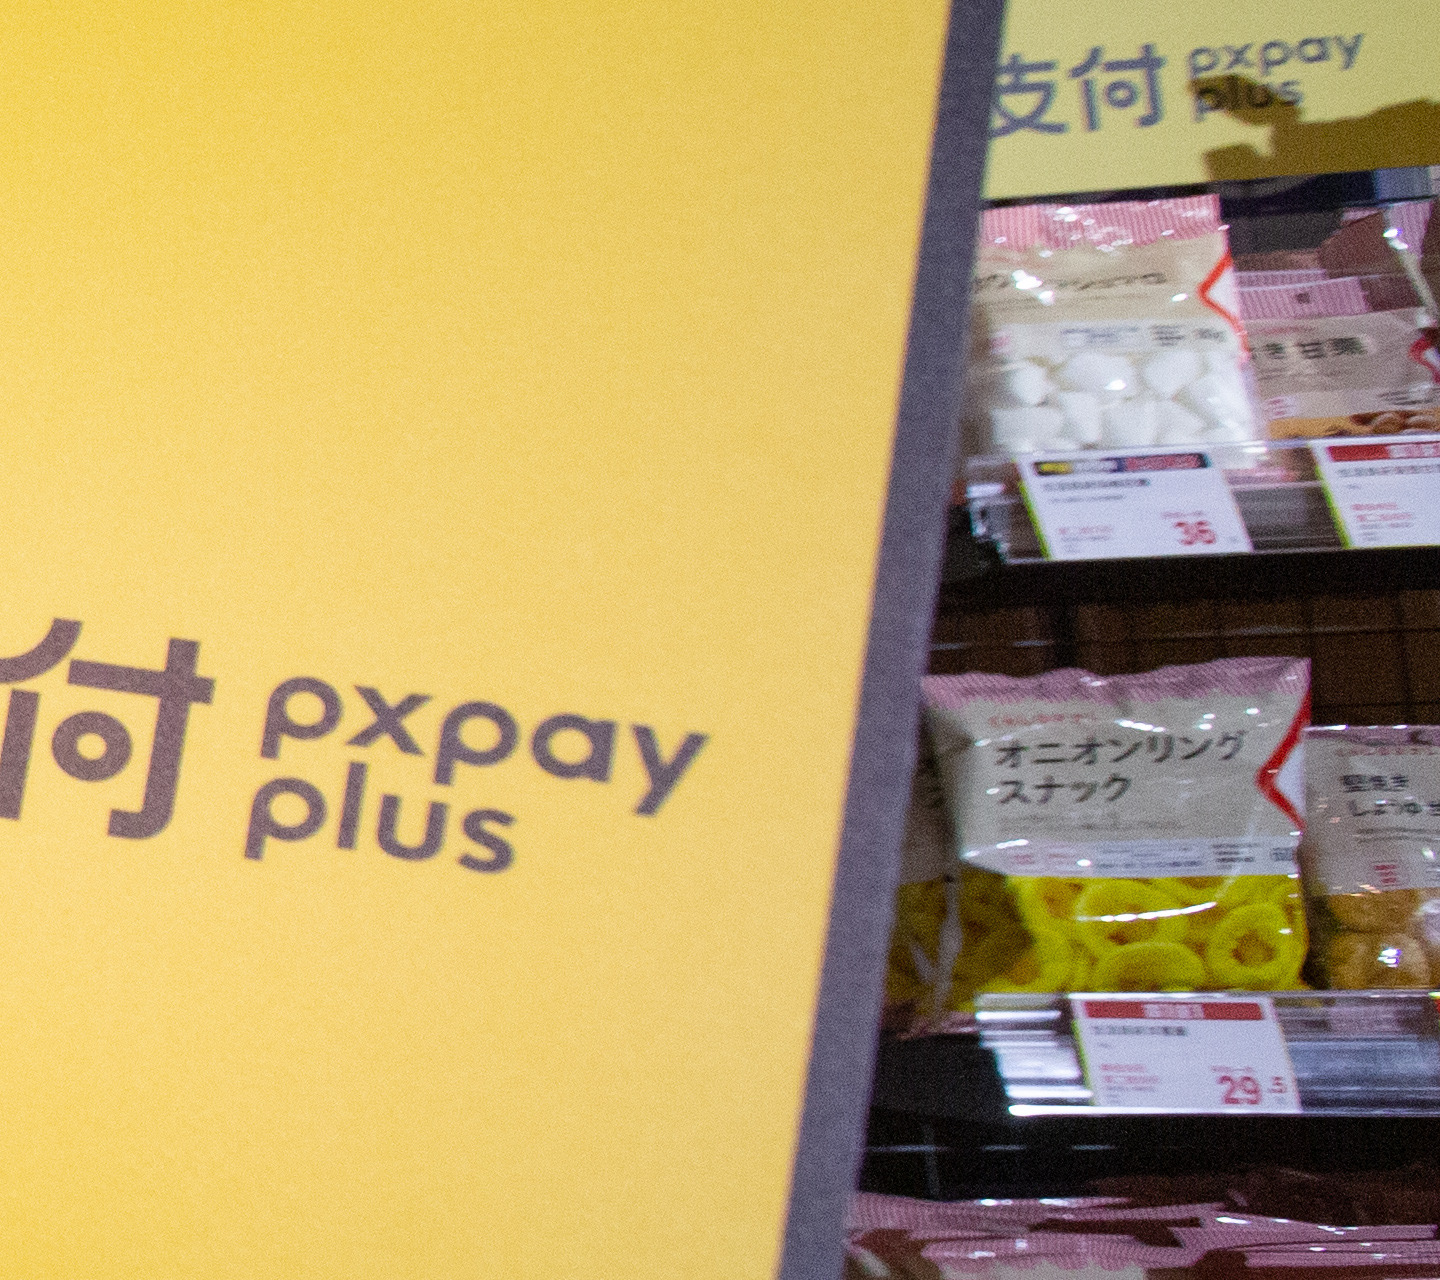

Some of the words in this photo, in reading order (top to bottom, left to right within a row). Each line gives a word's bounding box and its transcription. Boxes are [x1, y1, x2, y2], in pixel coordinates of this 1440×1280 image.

[1186, 32, 1367, 77] pxpay
[1194, 78, 1305, 123] plus
[259, 673, 711, 818] pxpay
[995, 729, 1247, 769] オニオンリング
[998, 773, 1132, 805] スナック
[242, 760, 517, 875] plus
